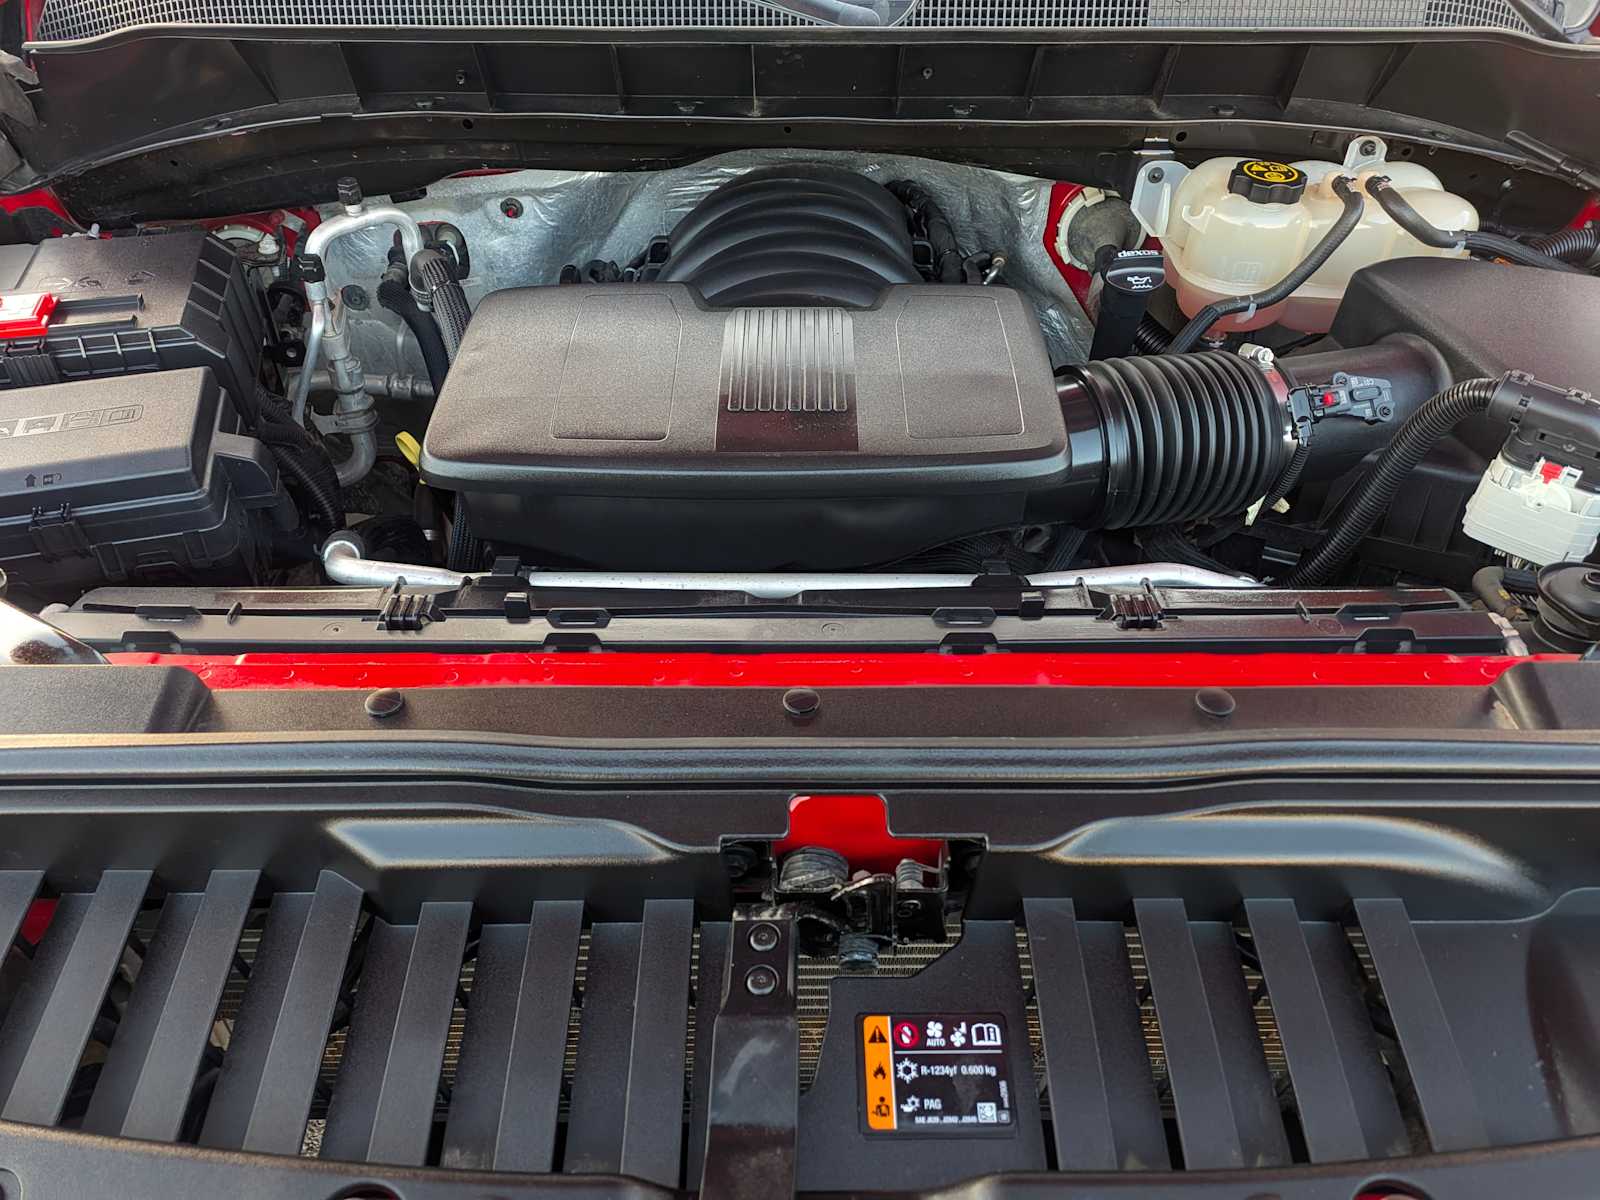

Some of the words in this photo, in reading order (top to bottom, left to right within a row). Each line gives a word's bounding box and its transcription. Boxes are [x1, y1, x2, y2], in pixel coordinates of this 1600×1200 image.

[926, 1038, 946, 1047] AUTO
[920, 1064, 958, 1078] R-1234yf
[960, 1064, 985, 1076] 0.600
[985, 1065, 997, 1078] kg
[923, 1098, 943, 1111] PAG
